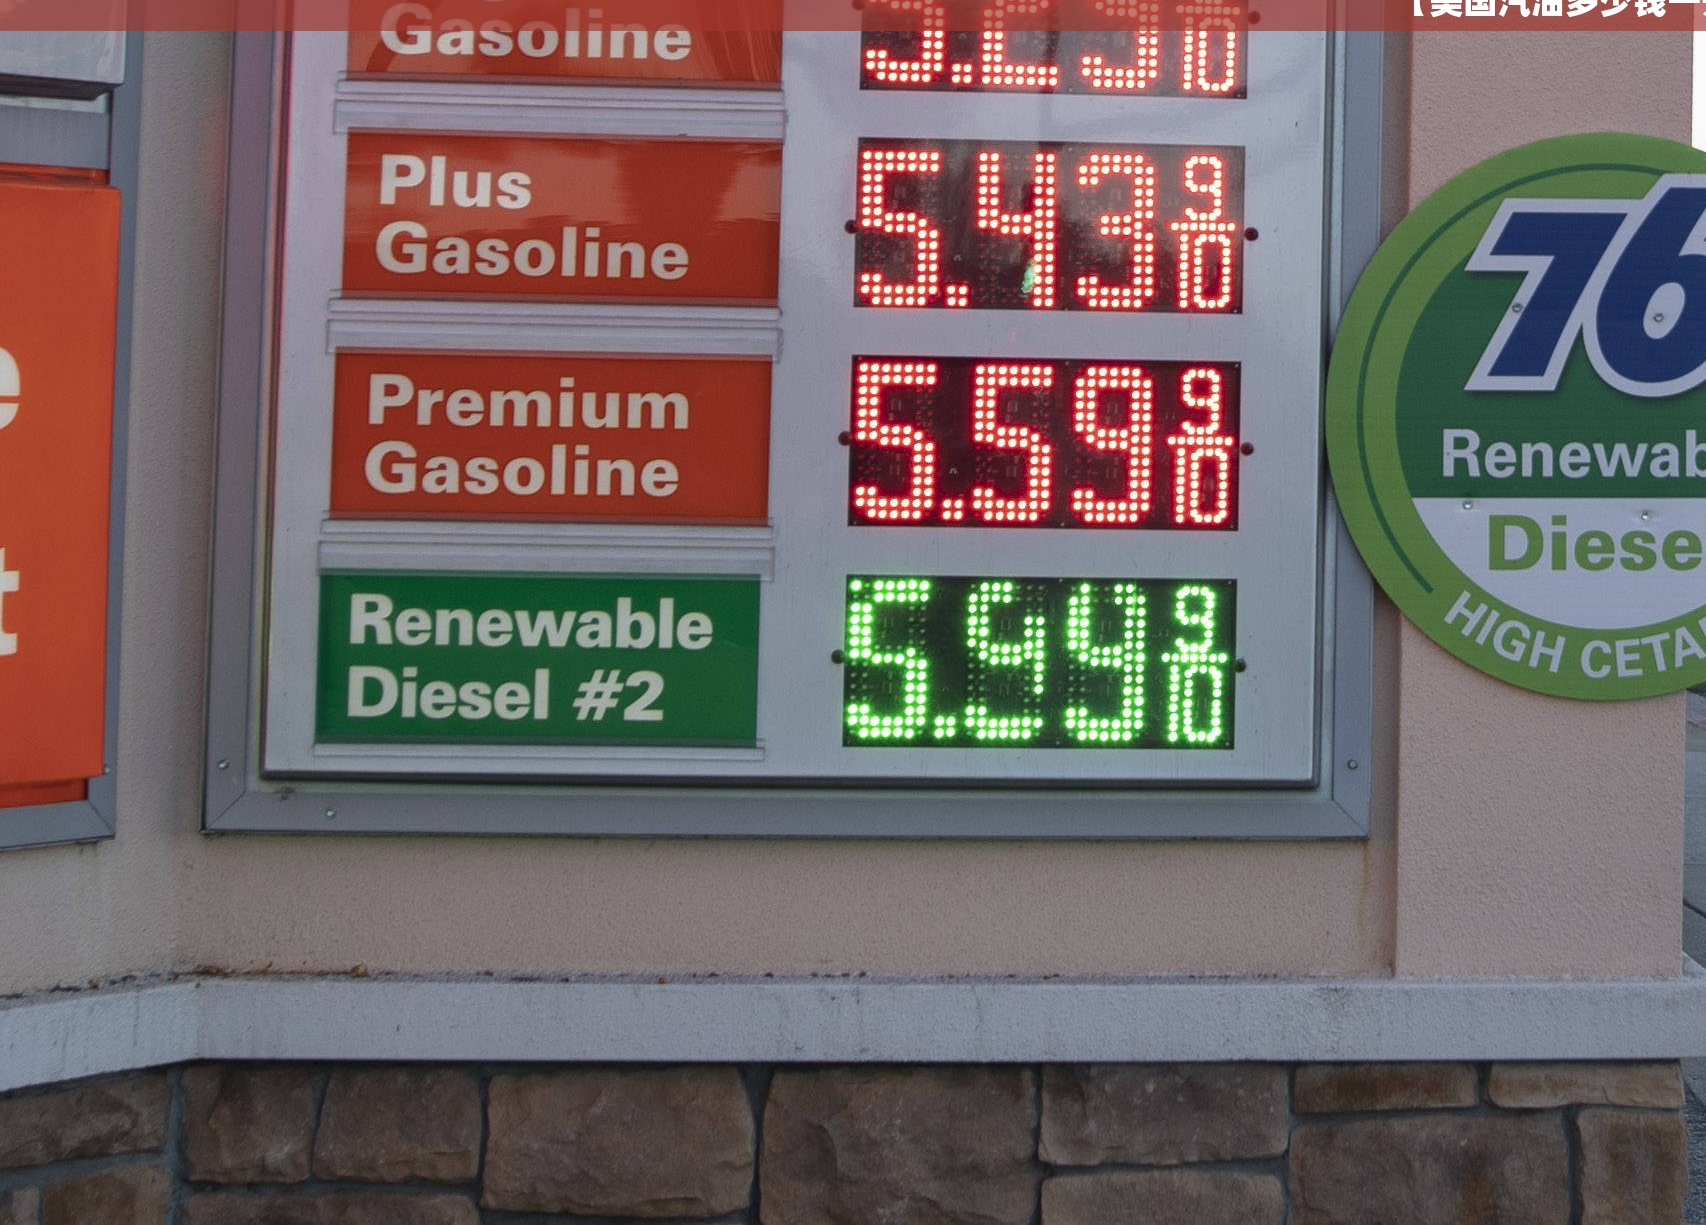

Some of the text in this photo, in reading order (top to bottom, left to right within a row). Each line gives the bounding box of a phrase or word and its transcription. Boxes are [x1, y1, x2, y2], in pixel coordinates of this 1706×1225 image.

[380, 3, 692, 62] Gasoline
[380, 154, 532, 210] Plus
[375, 220, 689, 280] Gasoline
[860, 150, 1155, 309] 5.43
[369, 374, 689, 429] Premium
[365, 441, 679, 497] Gasoline
[856, 362, 1152, 523] 5.59
[349, 593, 713, 650] Renewable
[1444, 590, 1567, 674] HIGH
[347, 665, 665, 721] Diesel #2
